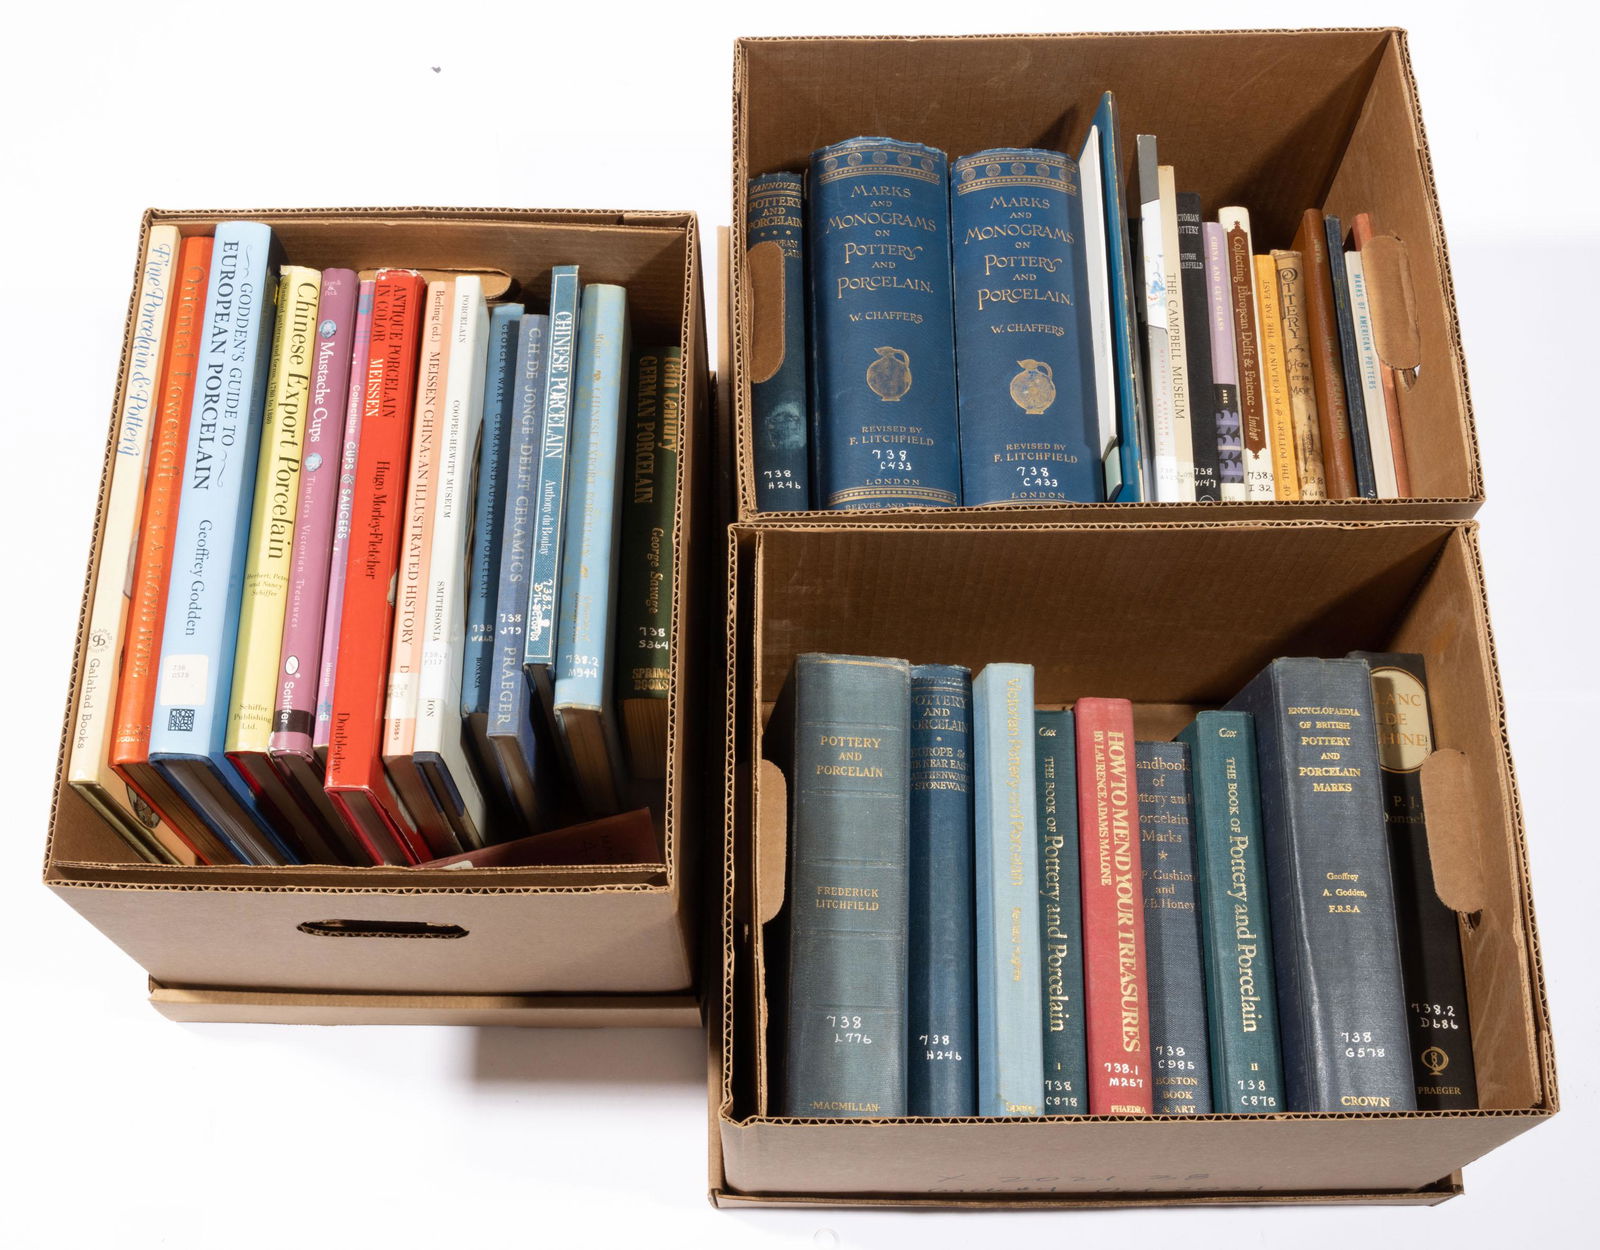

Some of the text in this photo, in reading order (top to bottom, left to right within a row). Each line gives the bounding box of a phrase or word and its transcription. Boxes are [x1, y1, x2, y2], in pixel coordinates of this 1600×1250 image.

[851, 185, 912, 198] MARKS
[990, 196, 1050, 209] MARKS
[762, 208, 785, 216] AND
[1009, 211, 1032, 219] AND
[826, 212, 937, 234] MONOGRAMS
[874, 229, 890, 237] ON
[964, 224, 1074, 245] MONOGRAMS
[843, 242, 924, 264] POTTERY
[1233, 236, 1247, 283] Collecting
[984, 254, 1063, 276] POTTERY
[837, 276, 934, 299] PORCELAIN.
[977, 288, 1074, 310] PORCELAIN.
[372, 285, 391, 342] IN COLOR
[1236, 286, 1252, 329] European
[459, 295, 470, 344] PORCELAIN
[849, 311, 924, 324] W. CHAFFERS
[991, 324, 1065, 337] W. CHAFFERS
[117, 243, 171, 456] Fine Porcelain & Pottery
[1167, 273, 1185, 419] THE CAMPBELL MUSEUM
[1241, 331, 1254, 357] Delft
[382, 285, 407, 418] ANTIQUE PORCELAIN
[192, 241, 239, 490] EUROPEAN PORCELAIN
[221, 283, 253, 447] GODDEN'S GUIDE TO
[309, 342, 335, 442] Mustache Cups
[365, 359, 384, 417] MEISSEN
[1245, 370, 1257, 405] Faience
[268, 282, 318, 560] Chinese Export Porcelain
[658, 393, 678, 452] Century
[540, 311, 573, 556] CHINESE PORCELAIN Anthony du Boulay
[634, 355, 657, 503] GERMAN PORCELAIN
[861, 425, 906, 433] REVISED
[1248, 416, 1261, 441] Imber
[849, 434, 934, 446] F. LITCHFIELD
[510, 328, 542, 582] C.H. DE JONGE DELFT CERAMICS
[872, 449, 907, 461] 738
[994, 452, 1078, 464] F. LITCHFIELD
[338, 385, 360, 539] Collectible CUPS & SAUCERS
[402, 290, 445, 646] Berling (ed.) MEISSEN CHINA: AN ILLUSTRATED HISTORY
[880, 461, 912, 471] C433
[764, 470, 792, 478] 738
[1016, 466, 1049, 477] 738
[866, 478, 920, 486] LONDON
[1023, 478, 1058, 487] C433
[1011, 491, 1065, 499] LONDON
[365, 461, 391, 580] Hugo Morley-Fletcher
[291, 476, 316, 628] Timeless Victorian Treasures
[647, 527, 664, 614] George Savage
[185, 519, 213, 636] Geoffrey Godden
[500, 614, 522, 623] 738
[639, 627, 665, 637] 738
[83, 658, 101, 709] Galahad
[498, 647, 517, 725] PRAEGER
[281, 681, 295, 725] Schiffer
[170, 708, 195, 716] CROSS
[923, 708, 951, 717] AND
[1288, 707, 1360, 716] ENCYCLOPAEDIA
[169, 716, 194, 724] RIVER
[233, 714, 271, 723] Publishing
[1299, 721, 1312, 729] OF
[1386, 713, 1408, 726] DE
[77, 714, 92, 749] Books
[168, 723, 193, 731] PRESS
[332, 713, 350, 774] Doubleday
[820, 736, 881, 748] POTTERY
[1301, 737, 1351, 746] POTTERY
[838, 752, 862, 761] AND
[816, 765, 883, 778] PORCELAIN
[1299, 767, 1360, 777] PORCELAIN
[1152, 774, 1166, 787] of
[1313, 783, 1353, 792] MARKS
[1093, 731, 1112, 886] BY LAURENCE ADAMS MALONE
[1142, 830, 1182, 843] Marks
[1326, 873, 1359, 882] Geoffrey
[817, 886, 879, 898] FREDERICK
[1040, 756, 1070, 1032] THE BOOK OF Pottery and Porcelain
[1107, 731, 1141, 1053] HOW TO MEND YOUR TREASURES
[1155, 884, 1175, 895] and
[1225, 757, 1263, 1033] THE BOOK OF Pottery and Porcelain
[1323, 889, 1367, 898] A. Godden,
[816, 900, 880, 911] LITCHFIELD
[827, 1016, 862, 1029] 738
[919, 1035, 950, 1046] 738
[1341, 1032, 1372, 1043] 738
[1156, 1046, 1185, 1057] 738
[1045, 1080, 1071, 1091] 738
[1155, 1077, 1198, 1086] BOSTON
[1237, 1080, 1266, 1091] 738
[1162, 1090, 1193, 1100] BOOK
[1418, 1086, 1462, 1095] PRAEGER
[813, 1101, 879, 1112] MACMILLAN
[1341, 1096, 1390, 1107] CROWN
[1110, 1104, 1146, 1113] PHAEDRA
